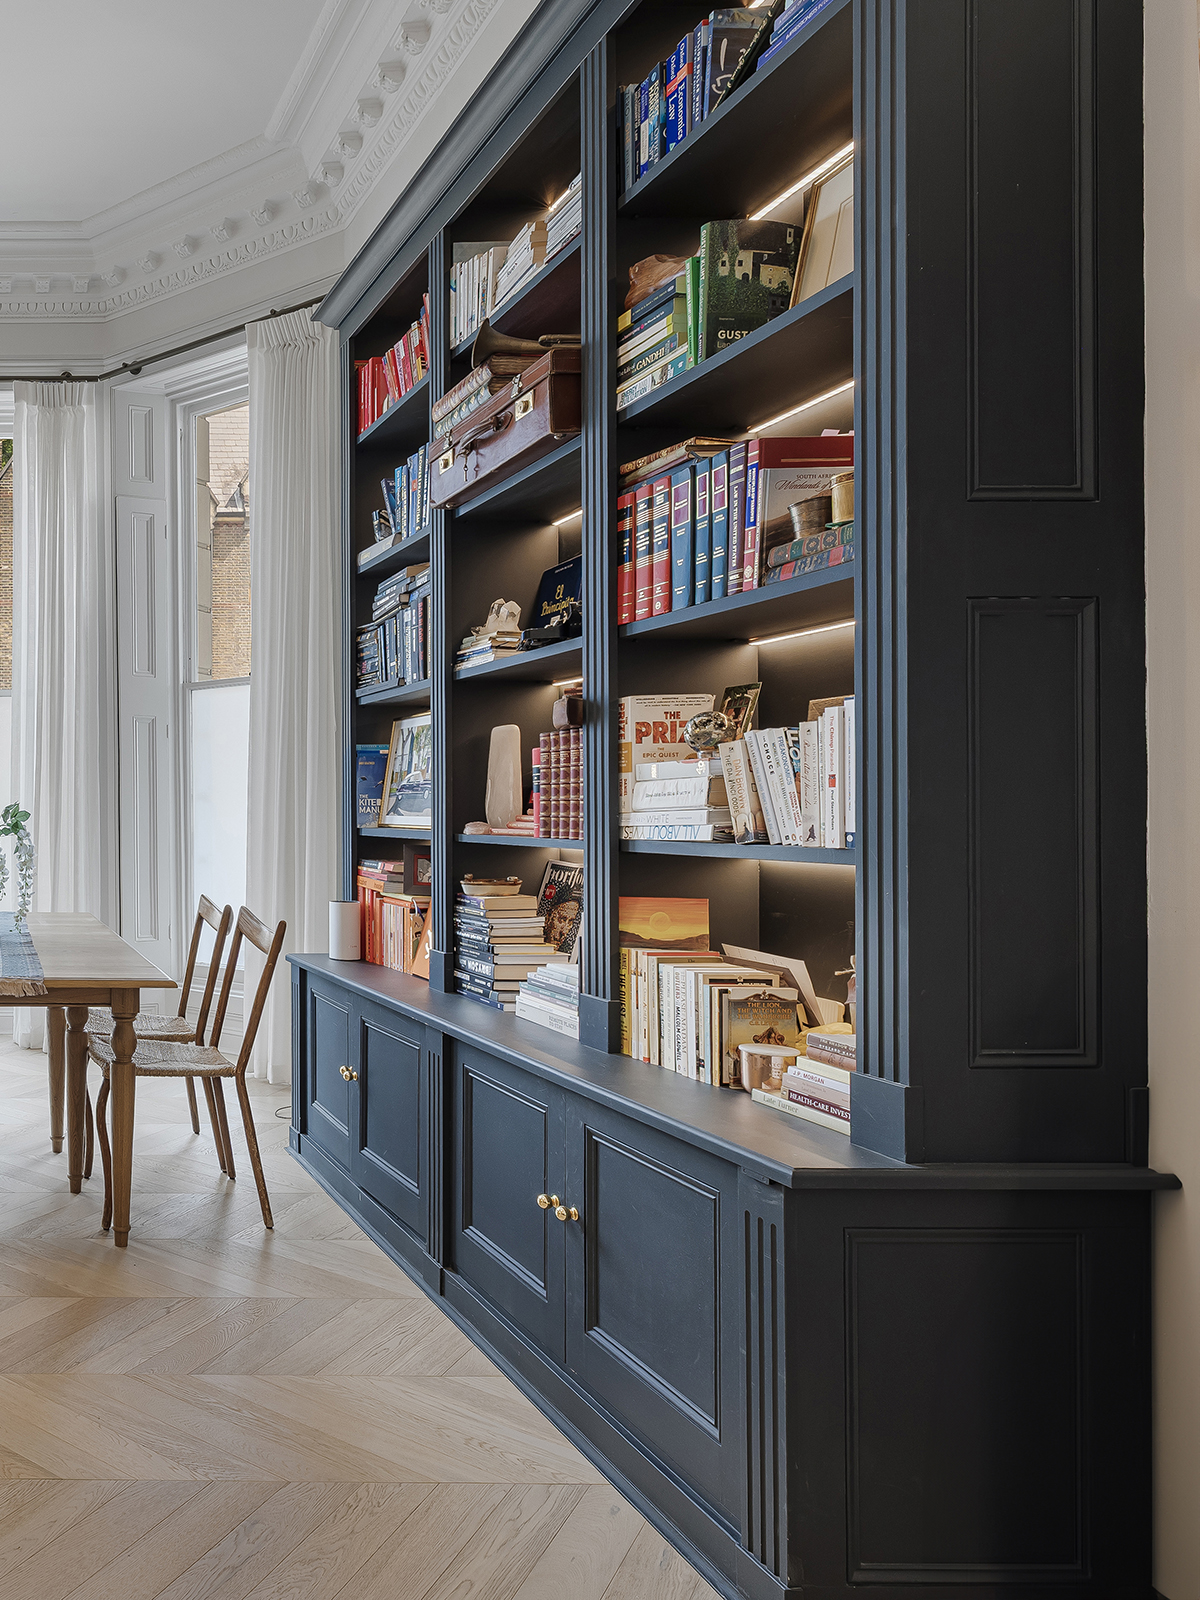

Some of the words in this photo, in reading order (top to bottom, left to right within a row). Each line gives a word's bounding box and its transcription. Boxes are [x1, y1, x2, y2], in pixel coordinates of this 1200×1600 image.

[678, 81, 686, 141] Economics
[717, 329, 753, 340] GUST
[636, 346, 664, 374] GANDHI
[774, 478, 820, 490] Winelands
[733, 499, 738, 508] IN
[555, 584, 565, 600] El
[663, 711, 681, 719] THE
[635, 720, 690, 744] PRIZ
[763, 743, 775, 775] CHOICE
[777, 735, 792, 785] FREAKONOMICS
[727, 768, 733, 777] DA
[733, 759, 743, 776] DAN
[728, 779, 736, 796] VINCI
[735, 777, 746, 809] BROWN
[731, 797, 739, 814] CODE
[647, 814, 669, 824] WHITE
[624, 826, 646, 839] YVES
[647, 826, 682, 840] ABOUT
[683, 826, 700, 840] ALL
[803, 1074, 825, 1084] MORGAN
[764, 1095, 776, 1105] Late
[778, 1100, 798, 1114] Turner
[790, 1092, 829, 1112] HEALTH-CARE
